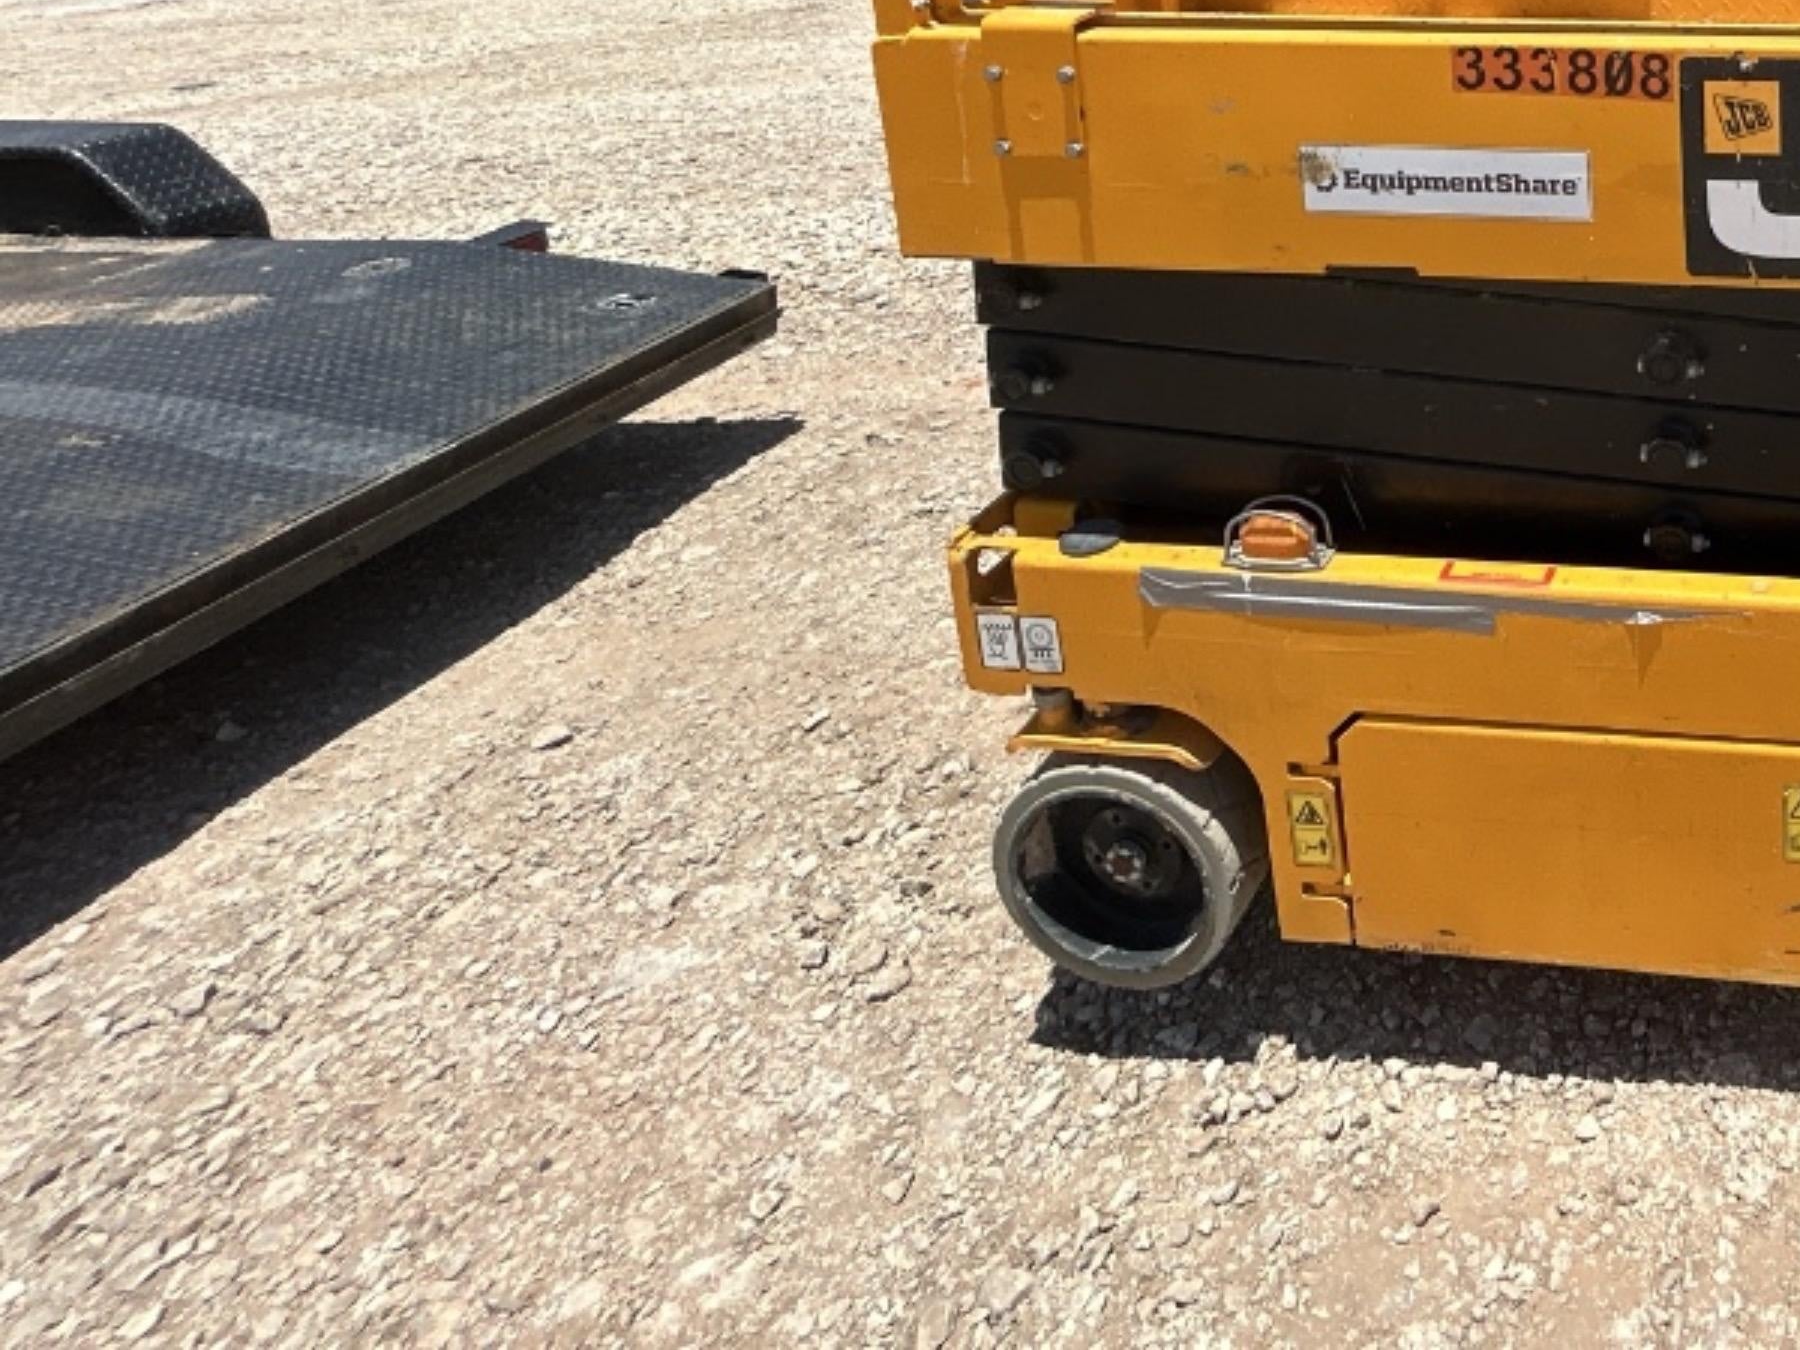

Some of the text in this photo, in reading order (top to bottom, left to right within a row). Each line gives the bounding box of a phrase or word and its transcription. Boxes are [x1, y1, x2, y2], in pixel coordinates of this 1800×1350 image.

[1456, 46, 1670, 99] 333808
[1711, 93, 1774, 141] JCB
[1343, 169, 1578, 196] EquipmentShare
